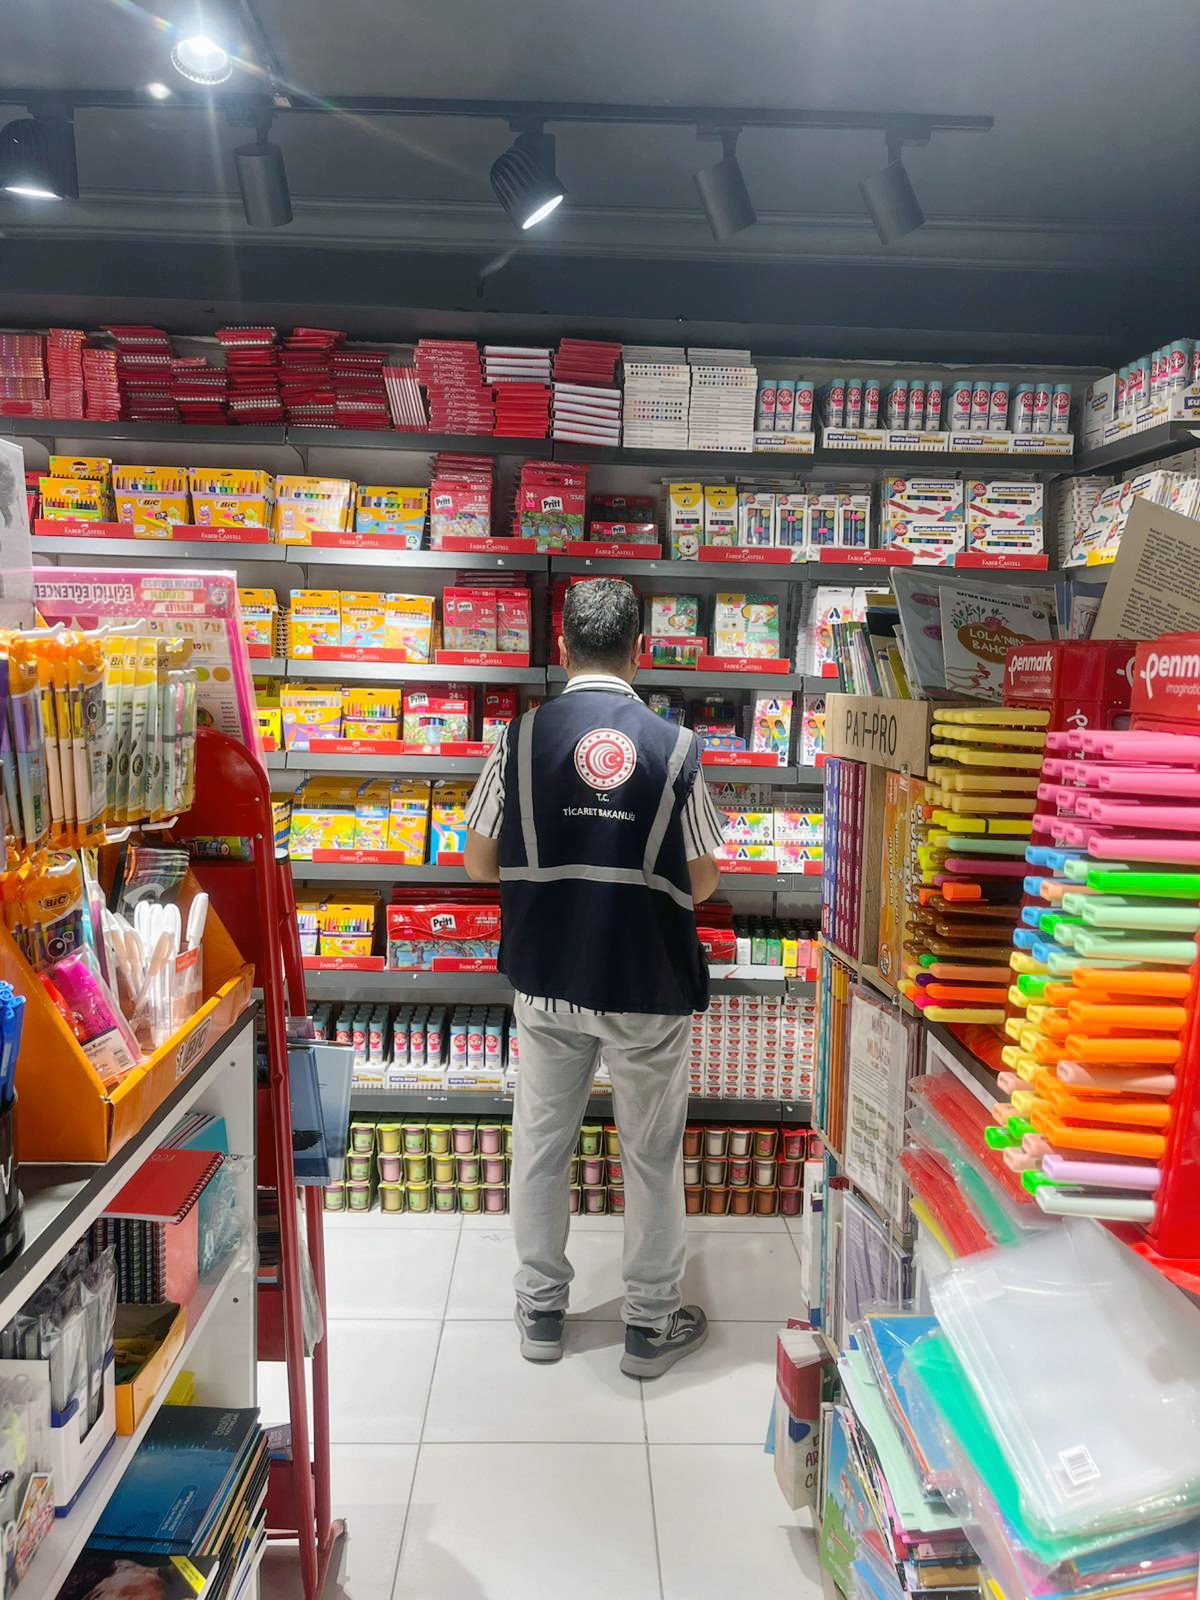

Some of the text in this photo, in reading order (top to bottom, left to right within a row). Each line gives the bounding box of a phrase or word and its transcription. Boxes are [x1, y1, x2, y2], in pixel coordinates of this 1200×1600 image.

[543, 500, 561, 509] Pritt
[1008, 650, 1053, 686] penmark
[1140, 653, 1200, 699] penm
[410, 695, 426, 704] Pritt
[846, 709, 897, 756] PAT-PRO
[562, 806, 598, 816] TİCARET
[433, 918, 453, 928] Pritt
